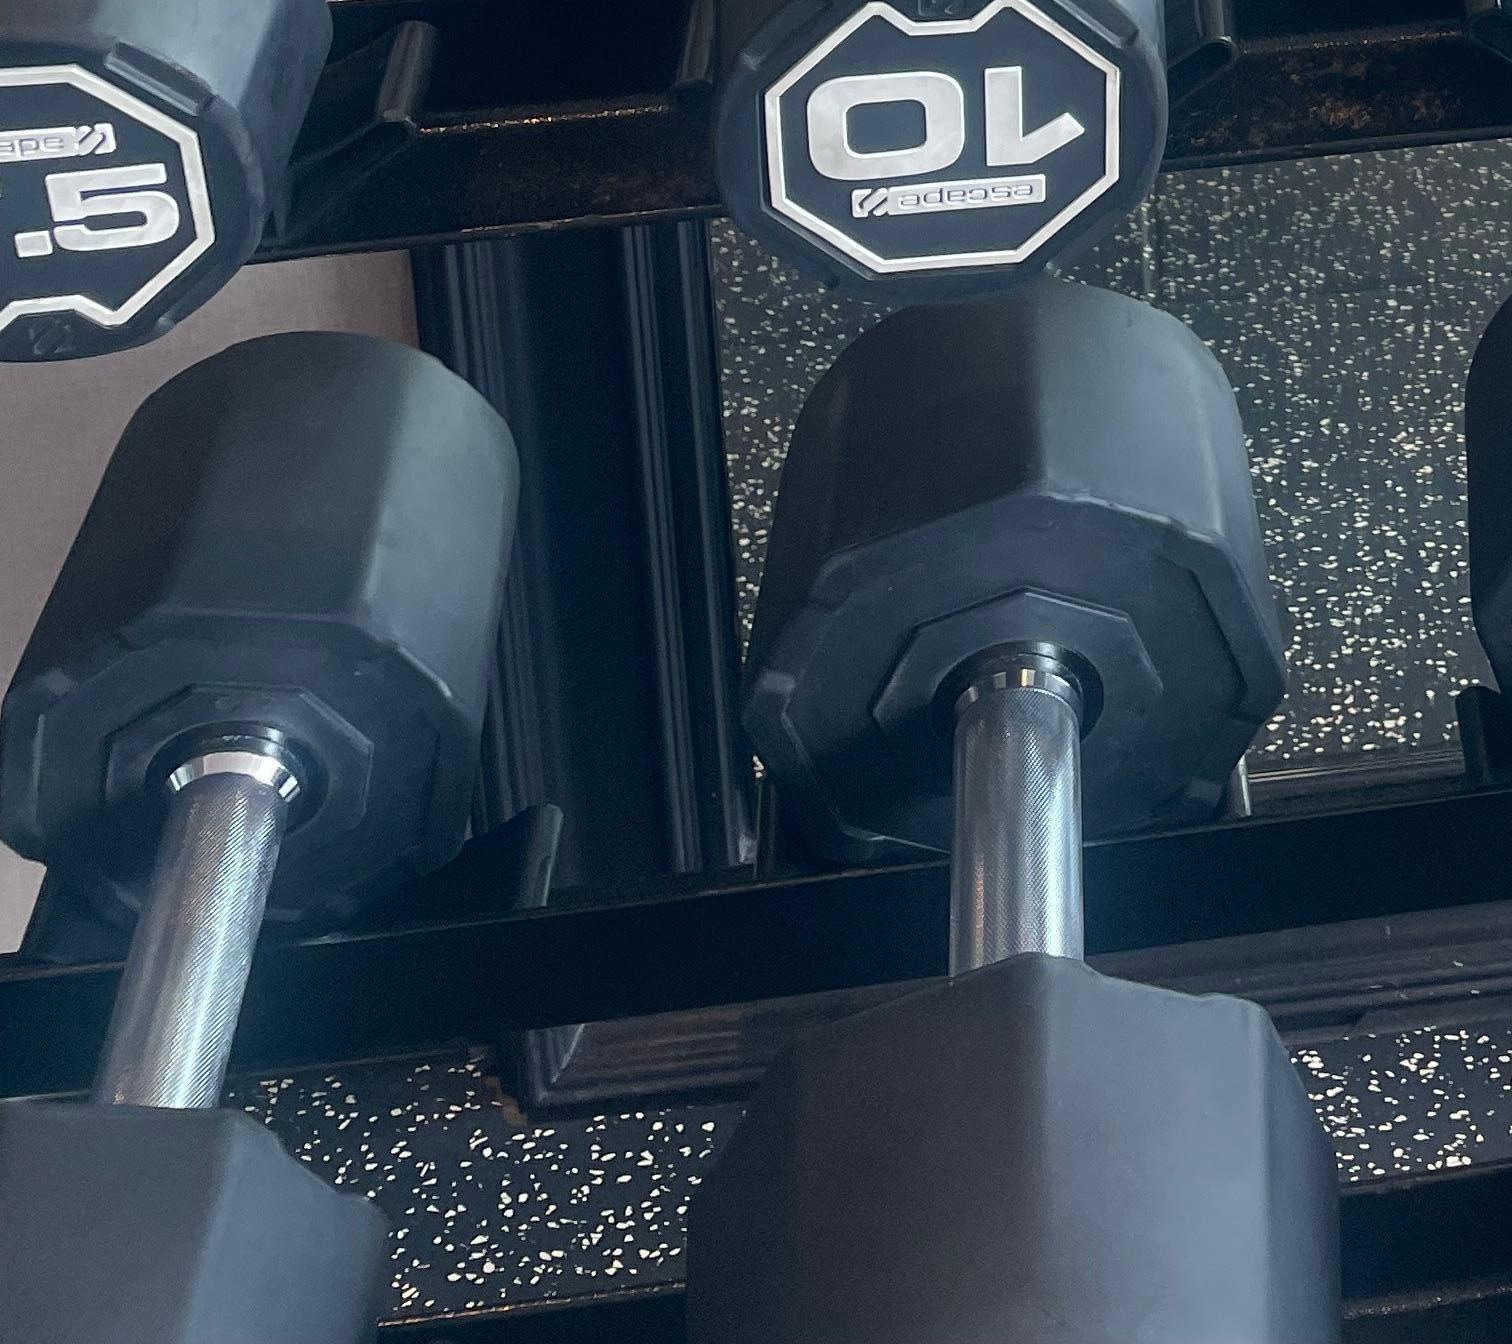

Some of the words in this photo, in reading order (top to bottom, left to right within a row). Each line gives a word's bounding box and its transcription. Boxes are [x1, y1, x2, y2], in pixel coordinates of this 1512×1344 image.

[0, 135, 65, 158] ape
[806, 66, 1086, 180] 10
[14, 163, 180, 258] .5
[897, 182, 1033, 207] escape
